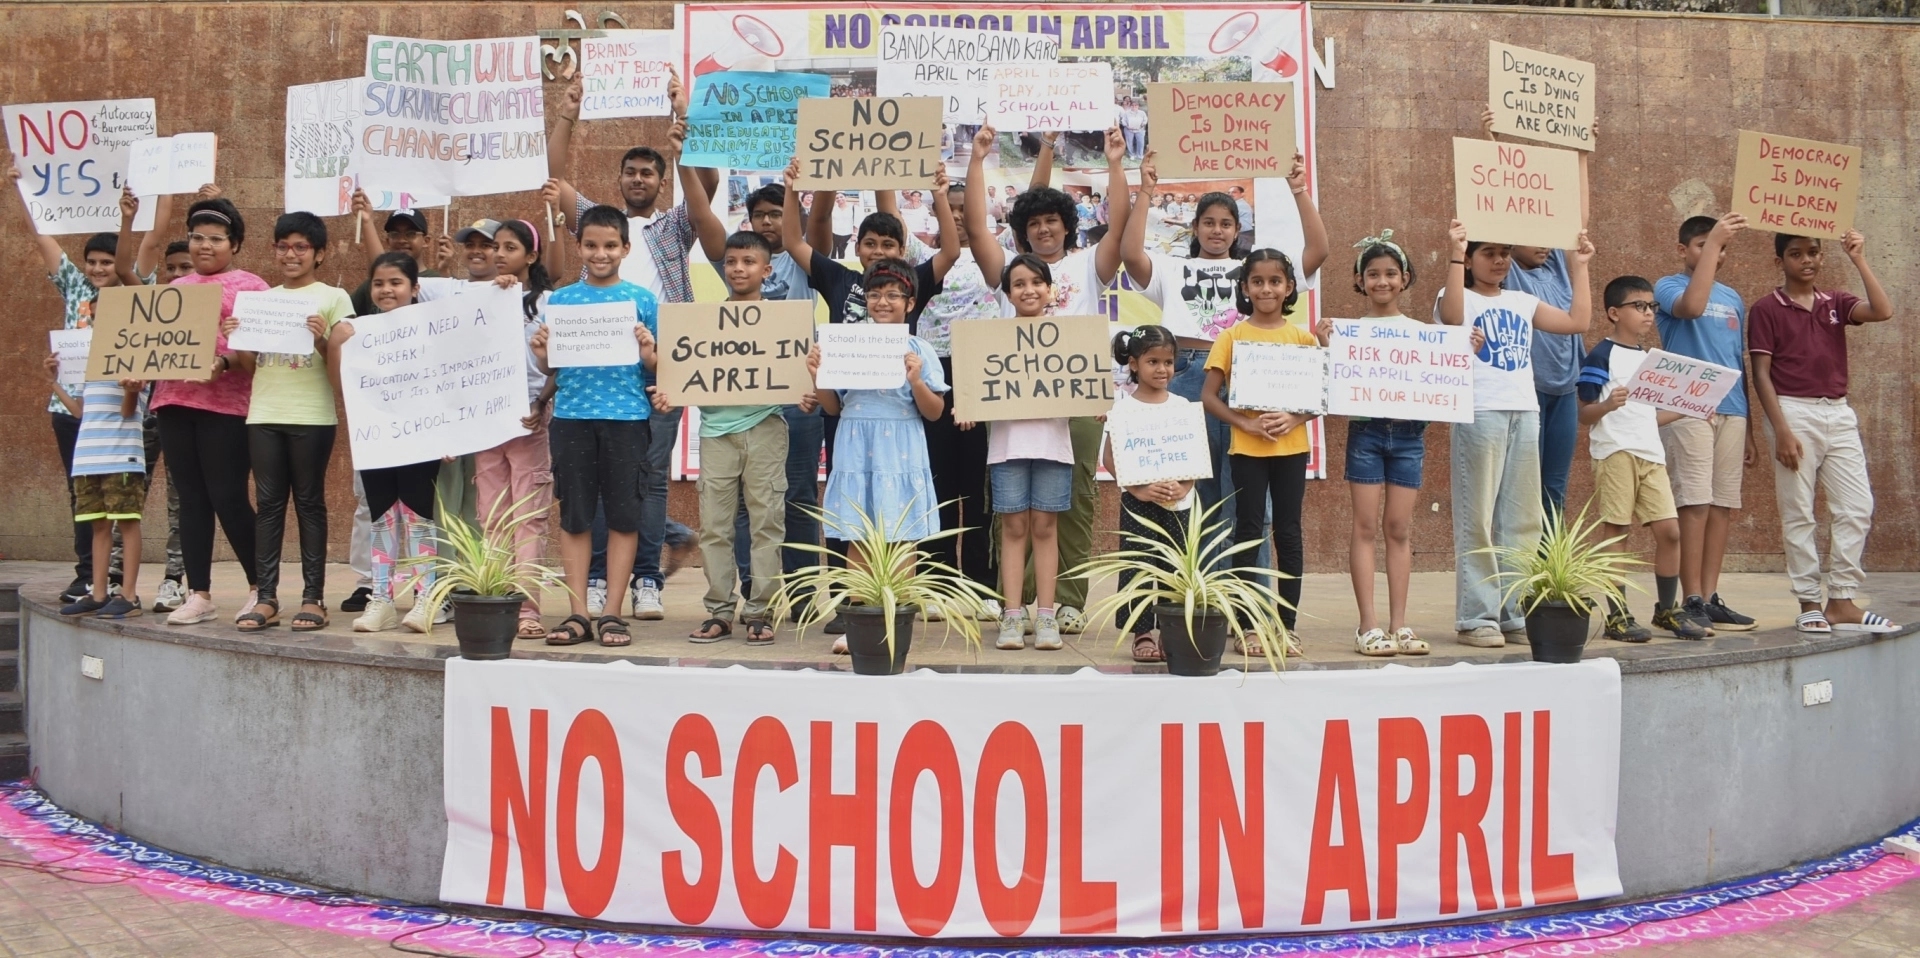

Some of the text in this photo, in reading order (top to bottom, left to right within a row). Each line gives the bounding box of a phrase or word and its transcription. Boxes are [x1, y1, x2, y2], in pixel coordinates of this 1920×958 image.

[825, 13, 871, 50] NO
[1071, 15, 1169, 50] APRIL
[585, 42, 637, 60] BRAINS
[1024, 37, 1059, 60] KARO
[370, 41, 471, 85] EARTH
[473, 42, 541, 82] WILL
[584, 60, 674, 77] CAN'T BLOOM
[914, 63, 958, 81] APRIL
[994, 67, 1099, 80] APRIL IS FOR
[1503, 50, 1585, 87] DEMOCRACY
[586, 76, 660, 92] IN A HOT
[702, 82, 740, 107] NO
[1048, 84, 1080, 96] NOT
[364, 82, 544, 124] SURVIVE CLIMATE
[583, 95, 665, 112] CLASSROOM!
[998, 100, 1060, 114] SCHOOL
[1069, 99, 1100, 111] ALL
[1172, 88, 1286, 112] DEMOCRACY
[1503, 91, 1576, 120] CHILDREN
[720, 108, 798, 124] IN APRI
[853, 98, 899, 127] NO
[1026, 115, 1072, 130] DAY!
[18, 109, 89, 157] NO
[690, 123, 725, 138] NEP:
[1516, 115, 1590, 141] ARE CRYING
[143, 145, 163, 157] NO
[362, 125, 472, 166] CHANGE,
[470, 131, 502, 160] WE
[809, 129, 936, 152] SCHOOL
[1178, 135, 1269, 154] CHILDREN
[177, 160, 207, 170] APRIL
[727, 155, 751, 168] BY
[1193, 154, 1279, 172] ARE CRYING
[1498, 145, 1526, 169] NO
[1759, 138, 1850, 171] DEMOCRACY
[32, 159, 101, 197] YES
[293, 156, 350, 178] SLEEP
[809, 157, 937, 180] IN APRIL
[1470, 165, 1554, 190] SCHOOL
[1477, 194, 1555, 217] IN APRIL
[1749, 185, 1838, 214] CHILDREN
[1760, 208, 1836, 233] ARE CRYING
[130, 287, 183, 324] NO
[279, 298, 309, 306] DEMOCRACY
[362, 308, 487, 349] CHILDREN NEED A
[554, 314, 635, 326] Dhondo Sarkaracho
[718, 305, 762, 331] NO
[114, 328, 202, 350] SCHOOL
[555, 329, 624, 338] Naxtt Amcho ani
[828, 334, 857, 343] School
[859, 334, 866, 343] is
[868, 335, 883, 344] the
[1016, 322, 1059, 352] NO
[1335, 324, 1448, 344] WE SHALL NOT
[377, 344, 426, 366] BREAK!
[556, 342, 613, 352] Bhurgeancho.
[671, 336, 810, 362] SCHOOL IN
[1349, 345, 1471, 370] RISK OUR LIVES,
[1490, 346, 1529, 371] LOVE
[102, 349, 202, 375] IN APRIL
[360, 351, 502, 389] EDUCATION IMPORTANT
[984, 353, 1112, 380] SCHOOL
[1655, 357, 1722, 382] DONT BE
[682, 366, 790, 393] APRIL
[1334, 363, 1470, 387] FOR APRIL SCHOOL
[981, 378, 1114, 402] IN APRIL
[1349, 386, 1457, 411] IN OUR LIVES!
[1684, 380, 1710, 397] NO
[1628, 386, 1714, 416] APRIL SCHOOL!
[355, 394, 511, 442] NO SCHOOL IN APRIL
[1124, 433, 1195, 451] APRIL SHOULD
[1138, 452, 1188, 468] BE FREE
[485, 705, 1579, 937] NO SCHOOL IN APRIL
